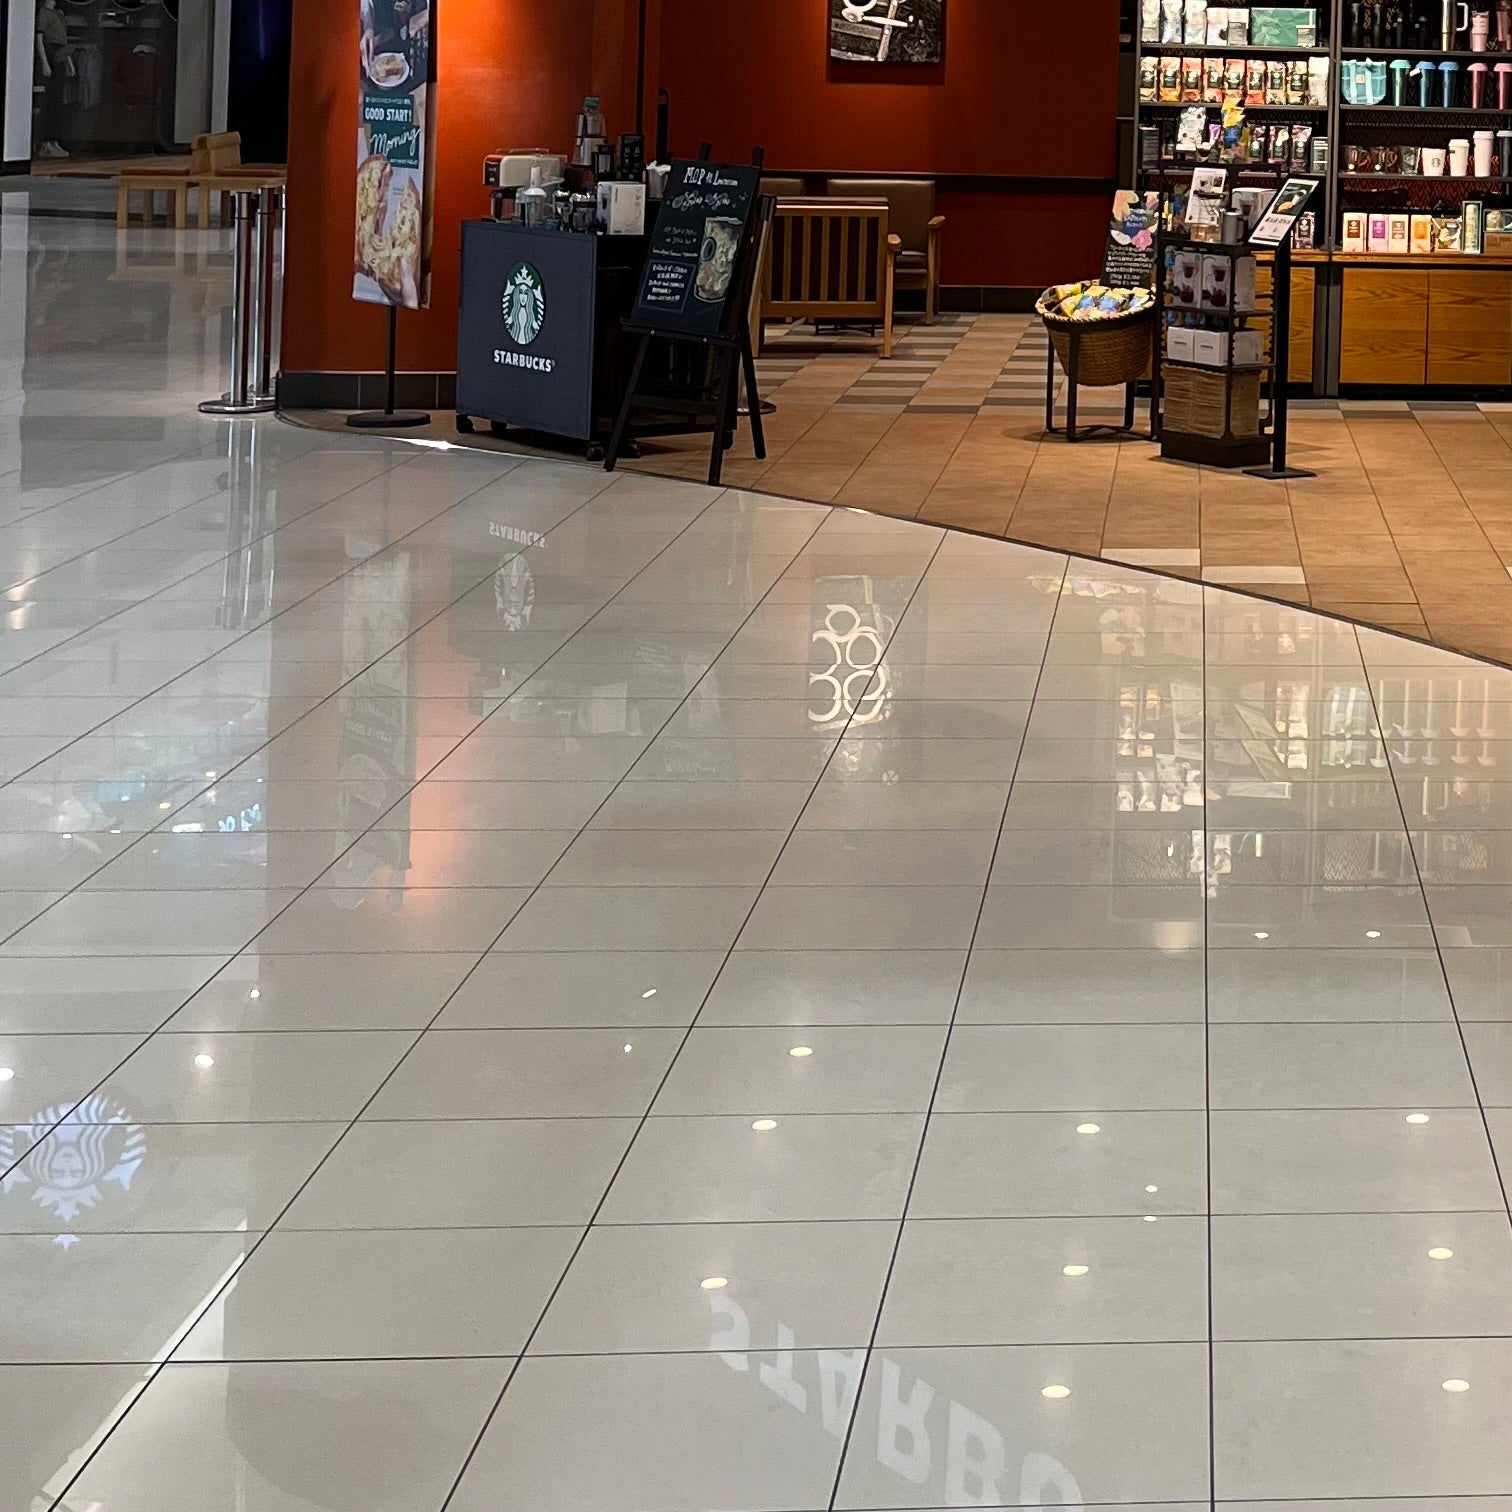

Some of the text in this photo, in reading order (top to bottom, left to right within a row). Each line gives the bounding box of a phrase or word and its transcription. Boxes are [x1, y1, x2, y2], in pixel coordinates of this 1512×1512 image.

[364, 107, 413, 123] GOOD START!
[370, 126, 421, 157] Morning
[493, 349, 553, 373] STARBUCKS
